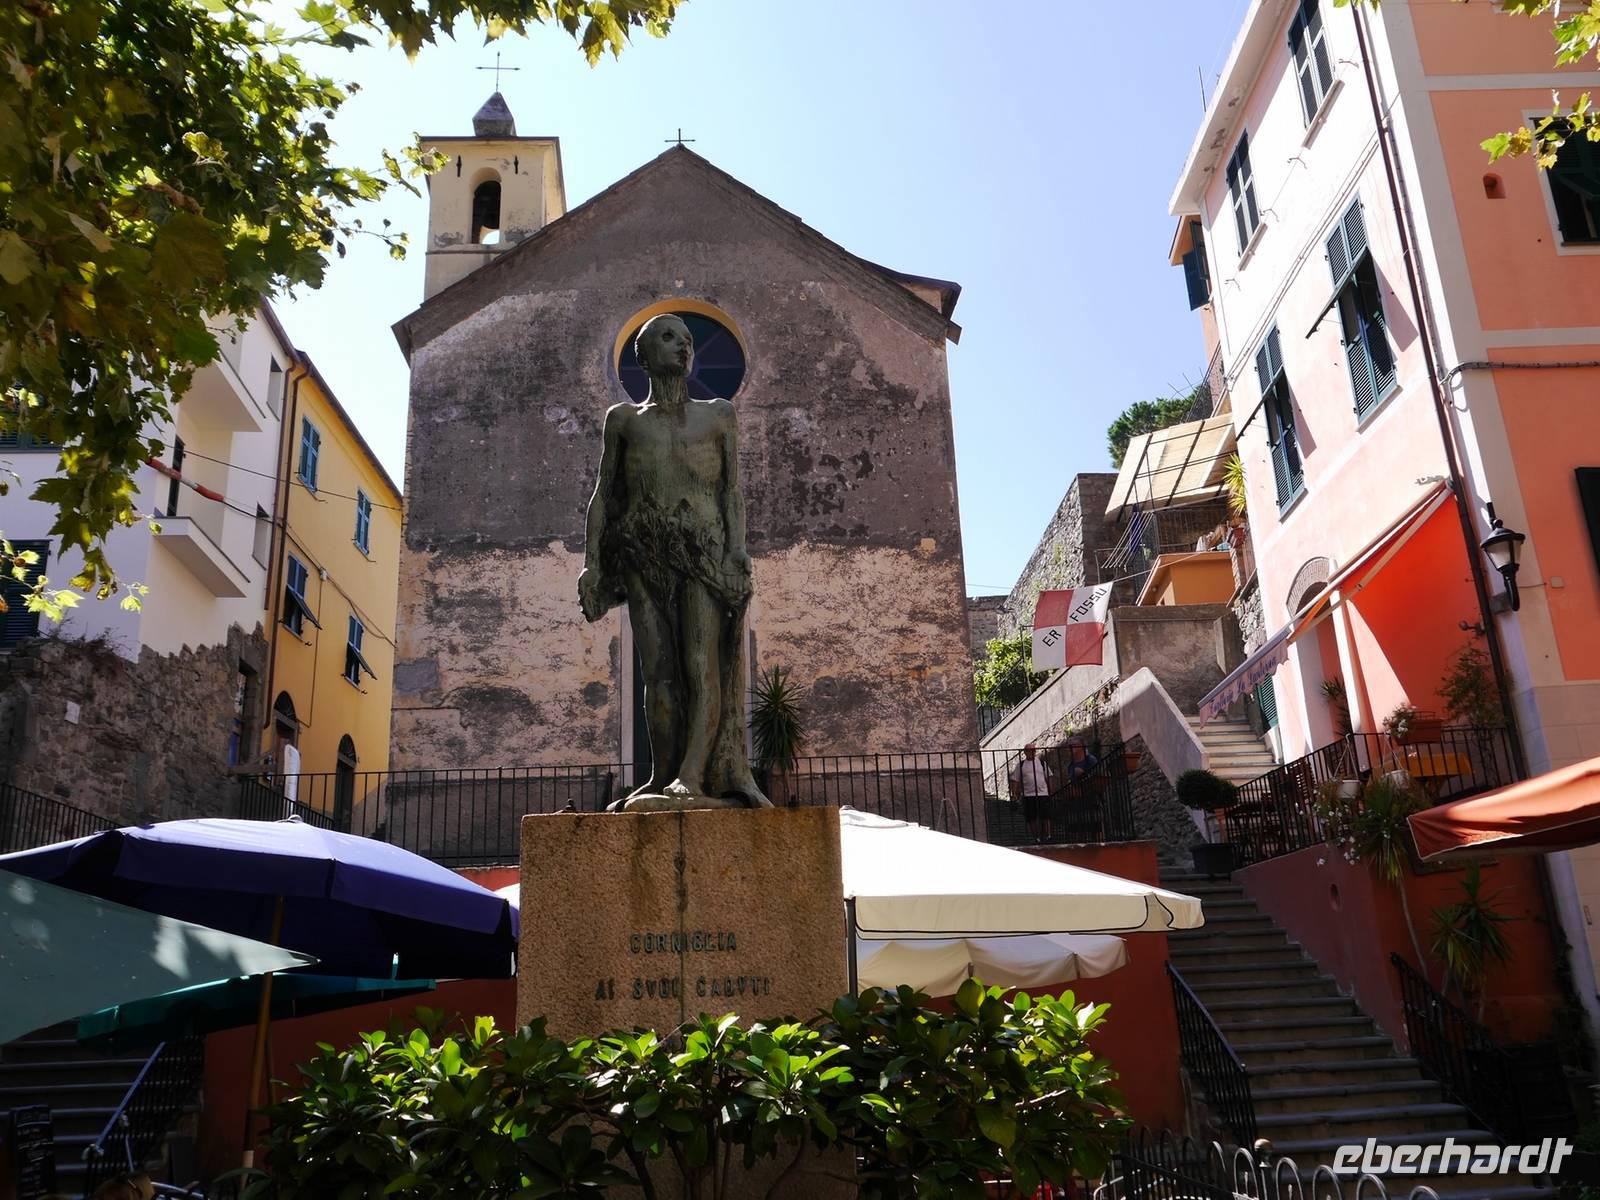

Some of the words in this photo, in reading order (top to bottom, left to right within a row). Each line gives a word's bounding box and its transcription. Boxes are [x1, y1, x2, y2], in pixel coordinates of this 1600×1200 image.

[1042, 629, 1062, 647] ER
[1069, 588, 1107, 622] FOSSU
[630, 930, 737, 954] CORNIGLIA
[595, 977, 615, 1000] AI
[696, 975, 770, 997] CADVTI
